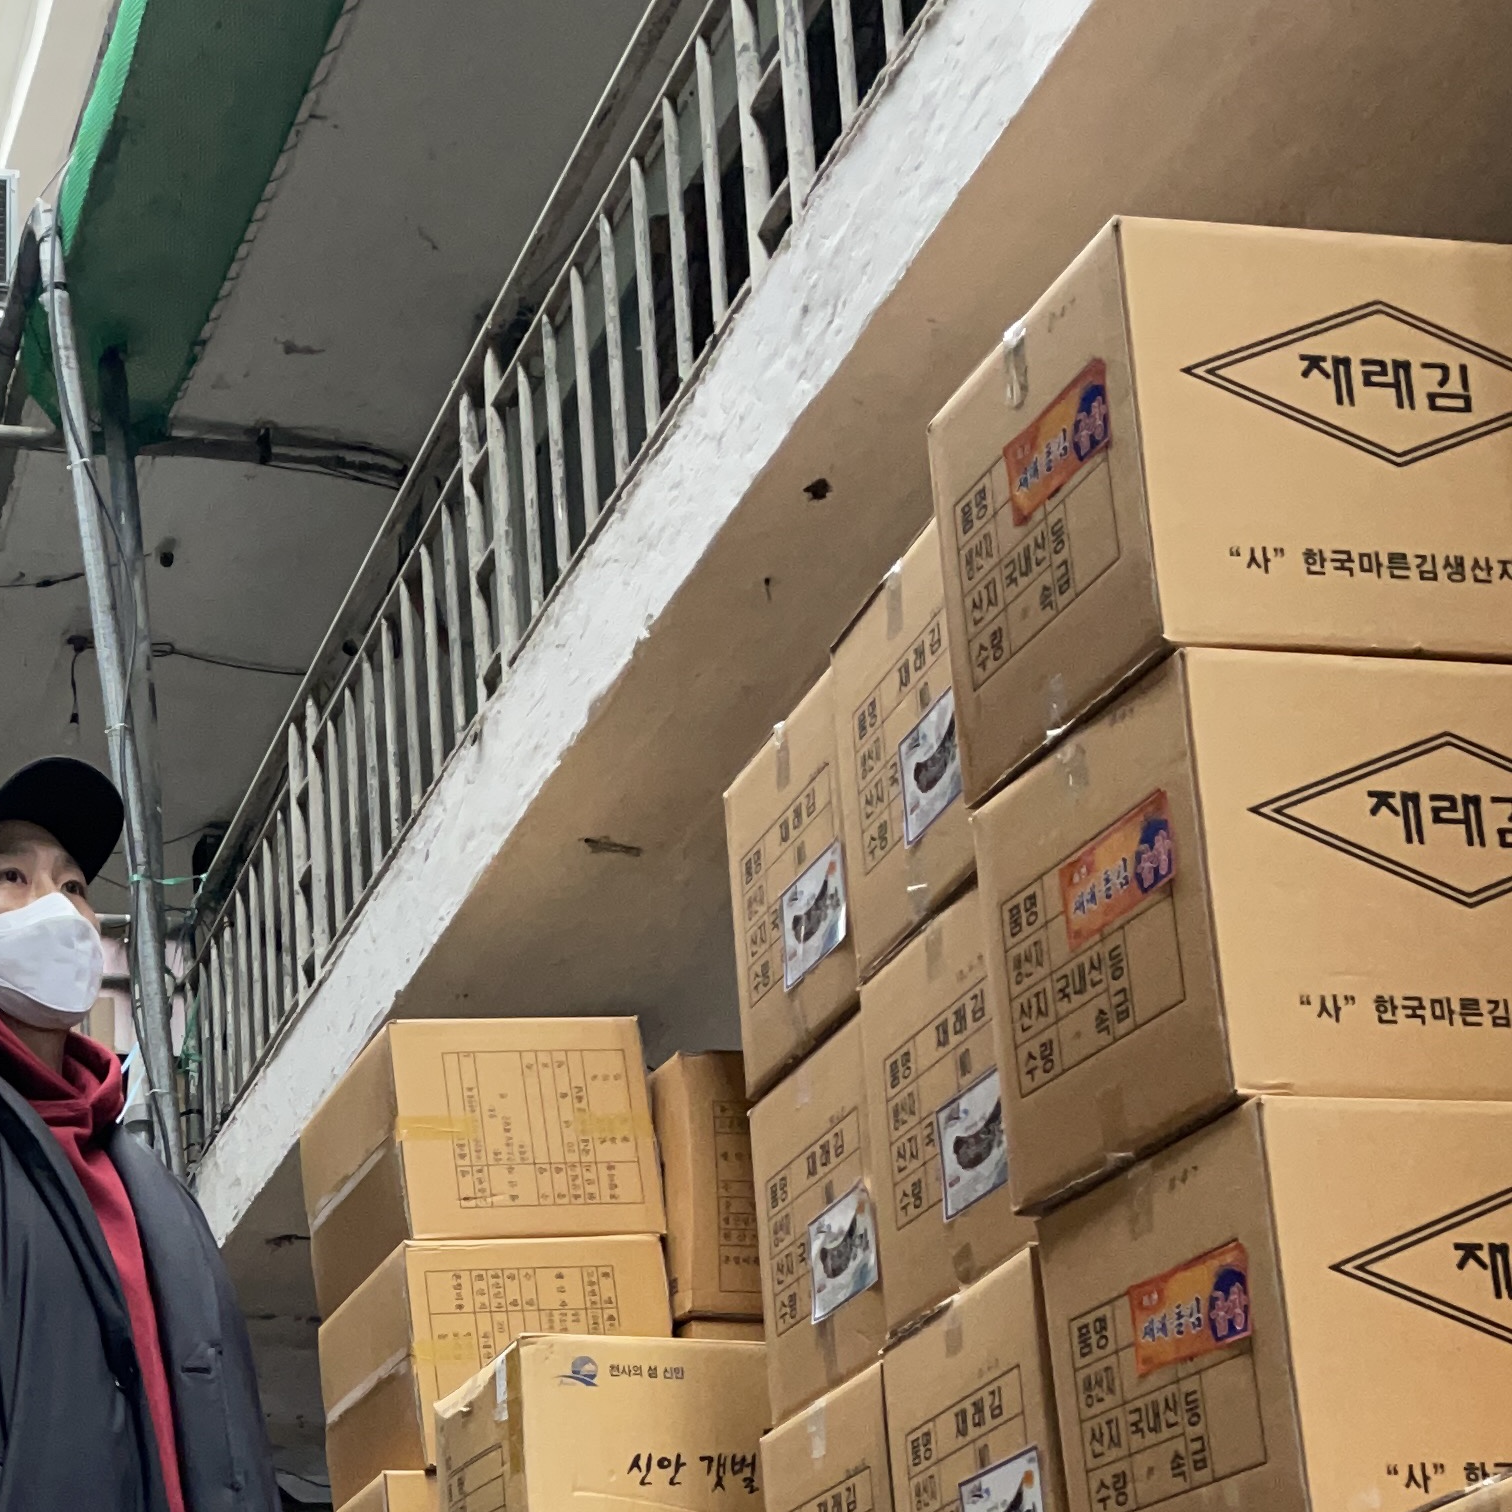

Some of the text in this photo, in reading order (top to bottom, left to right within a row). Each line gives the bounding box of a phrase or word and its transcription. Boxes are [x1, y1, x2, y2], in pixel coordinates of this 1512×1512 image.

[1299, 353, 1473, 413] 재래김
[960, 485, 988, 534] 품명
[968, 581, 999, 627] 산지
[974, 626, 1005, 673] 수량
[1007, 891, 1039, 937] 품명
[1016, 992, 1049, 1032] 산지
[1023, 1041, 1056, 1083] 수량
[1077, 1314, 1109, 1358] 품명
[1089, 1416, 1122, 1457] 산지
[627, 1452, 759, 1494] 신안 갯벌
[1095, 1470, 1129, 1512] 수량
